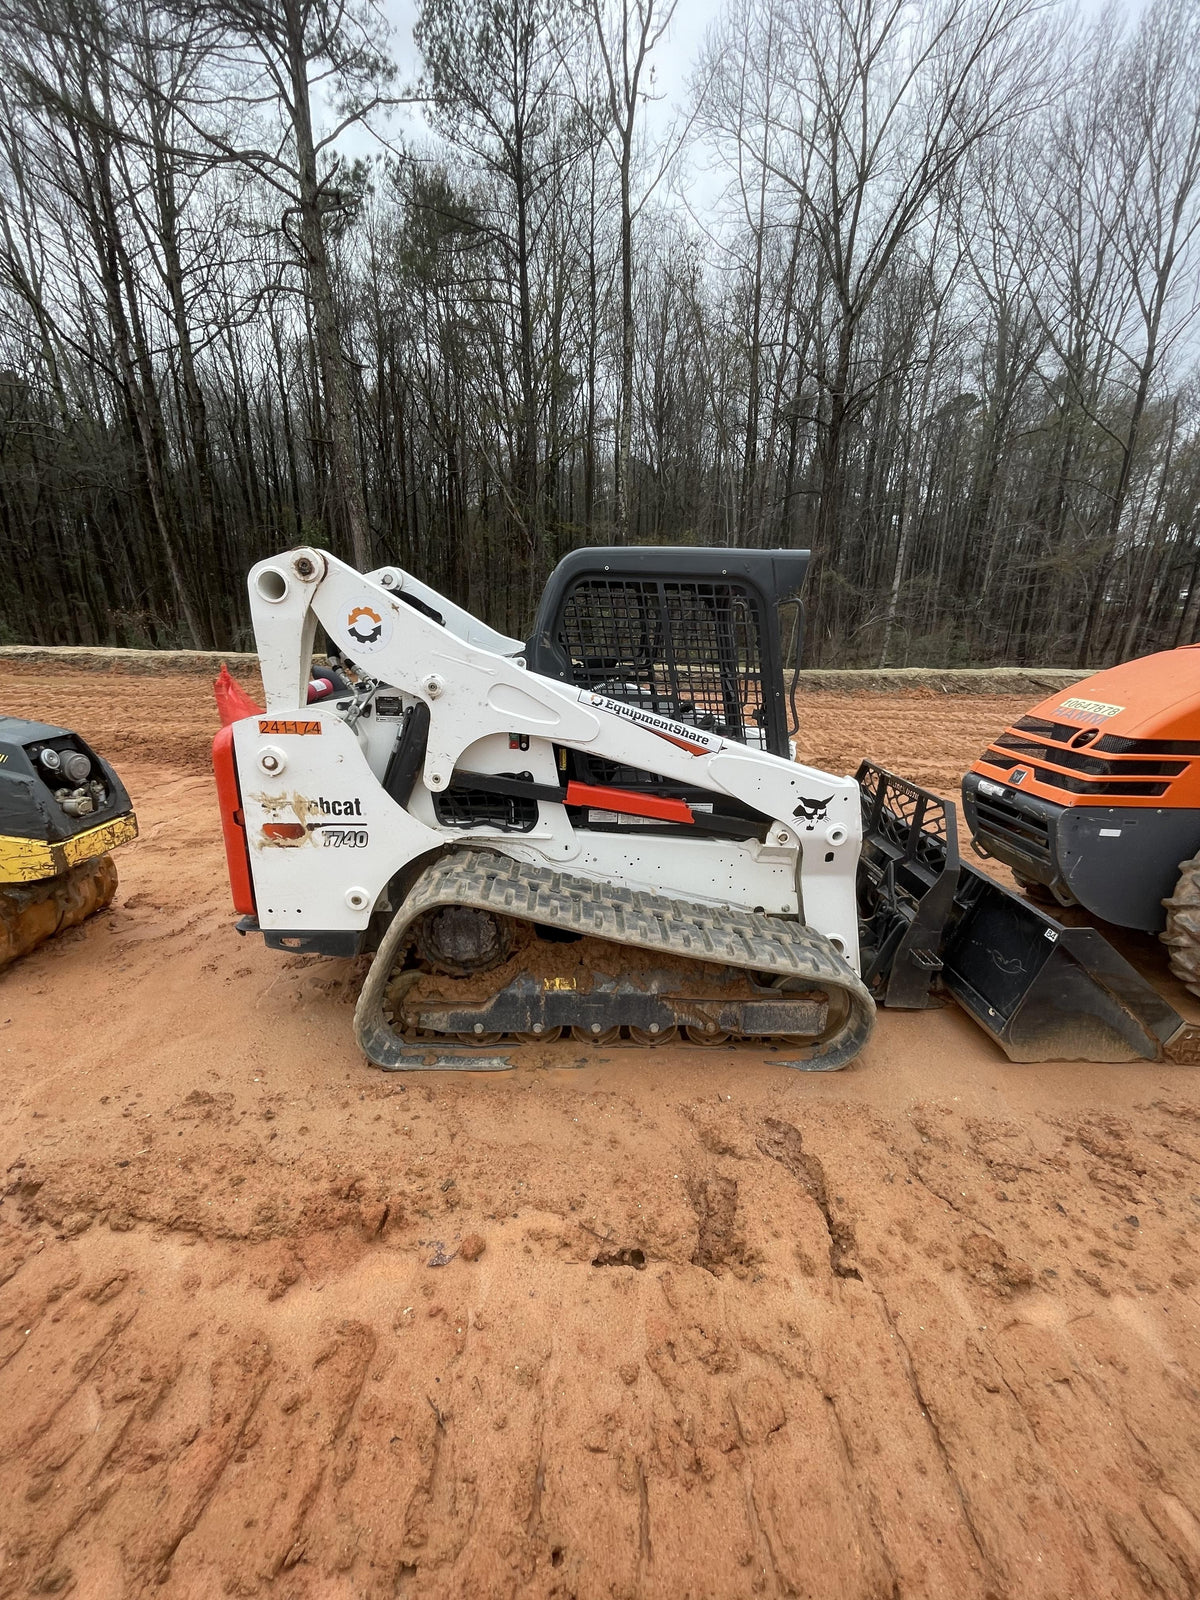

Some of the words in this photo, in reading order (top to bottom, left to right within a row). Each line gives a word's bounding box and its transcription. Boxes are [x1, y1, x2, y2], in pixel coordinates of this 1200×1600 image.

[1063, 699, 1121, 716] 10647878
[260, 720, 320, 734] 241174
[605, 699, 709, 745] EquipmentShare
[321, 830, 368, 848] T740
